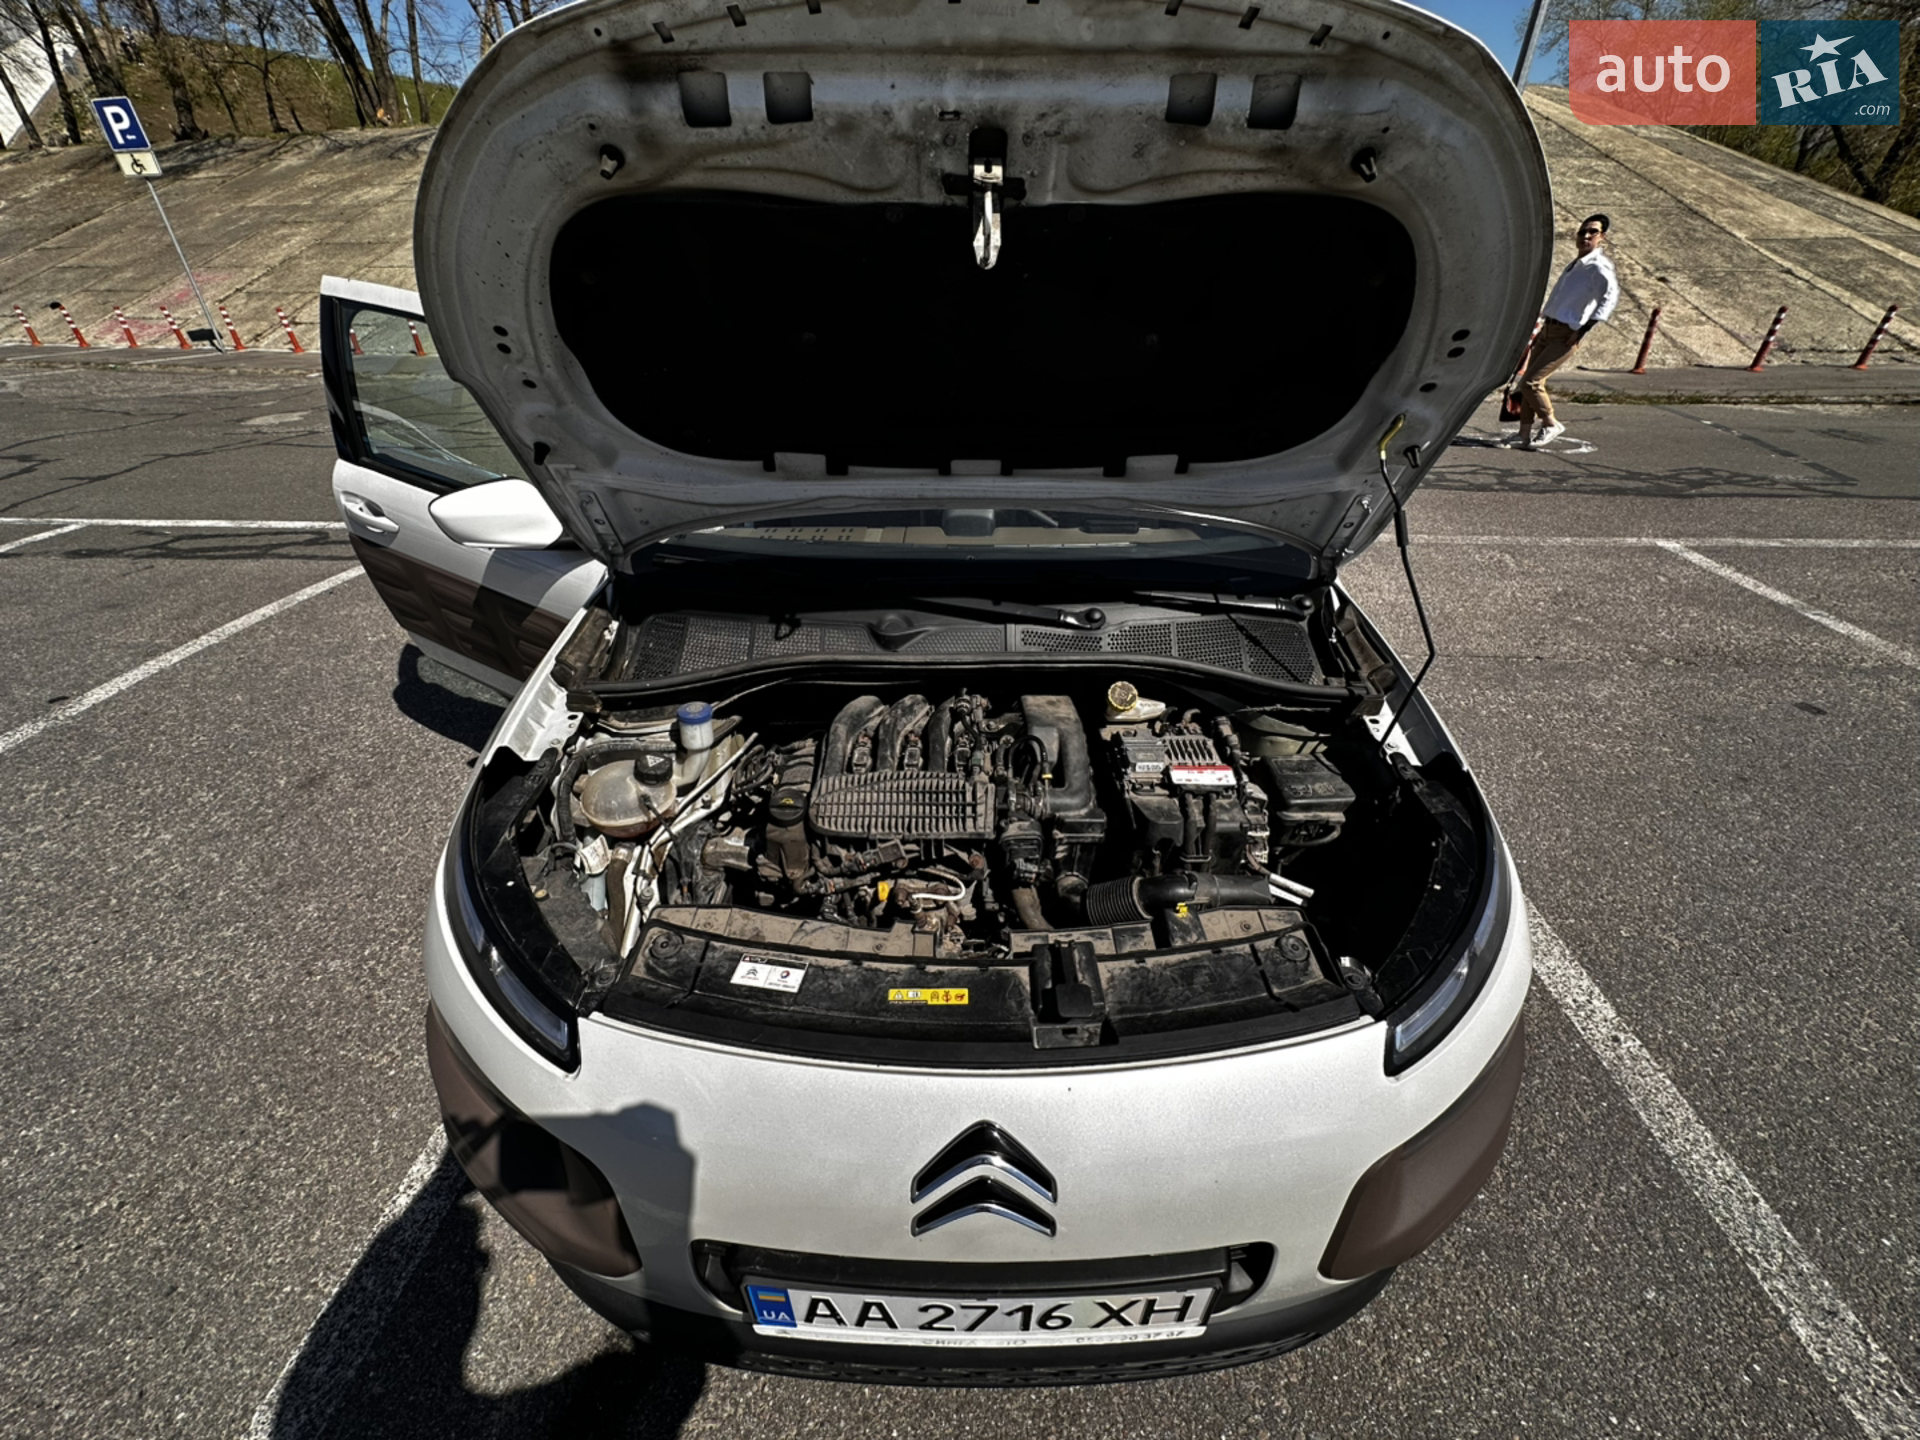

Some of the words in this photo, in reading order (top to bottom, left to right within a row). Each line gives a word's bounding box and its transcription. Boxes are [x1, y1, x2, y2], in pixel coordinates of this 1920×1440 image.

[102, 105, 131, 145] P
[762, 1310, 791, 1321] UA
[803, 1297, 899, 1330] AA
[917, 1302, 1073, 1333] 2716
[1090, 1294, 1196, 1329] XH
